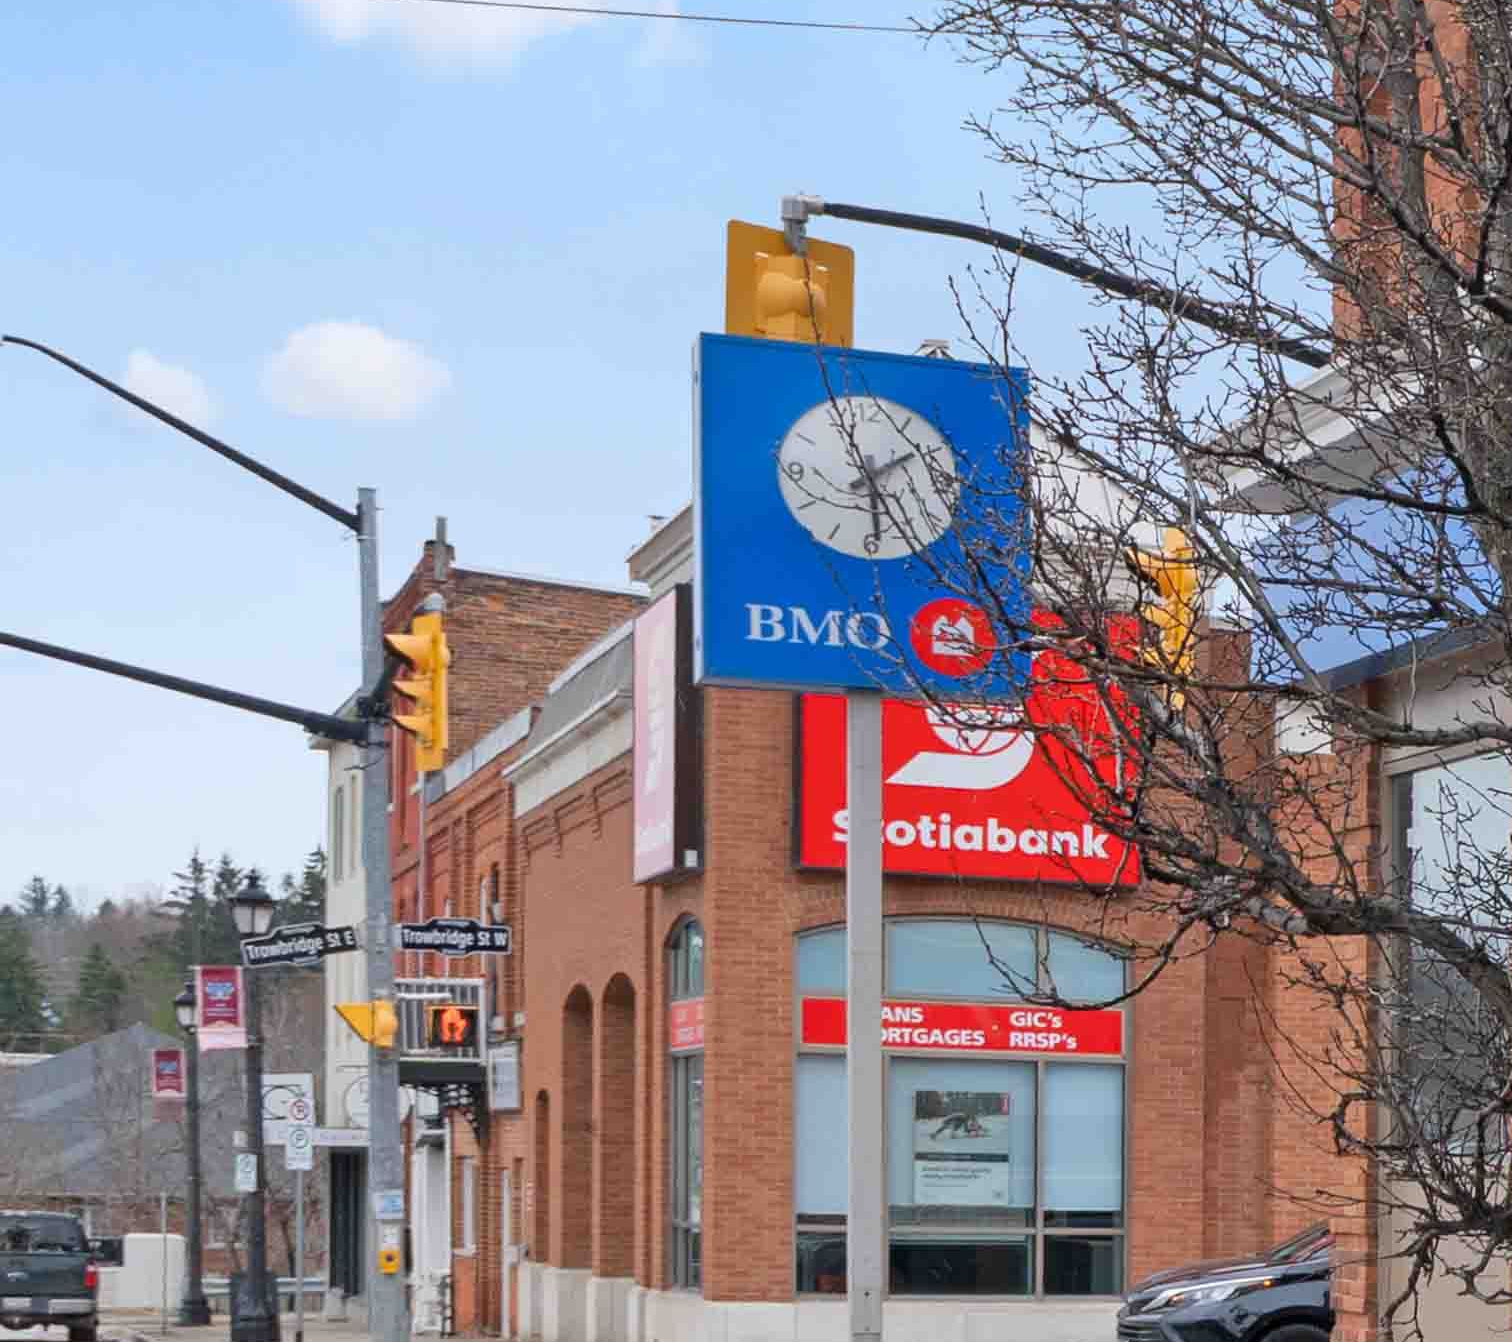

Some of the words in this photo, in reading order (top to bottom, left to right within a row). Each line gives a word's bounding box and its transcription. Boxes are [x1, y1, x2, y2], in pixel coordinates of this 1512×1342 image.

[745, 603, 891, 652] BMO
[832, 808, 1109, 859] Sotiabank
[246, 935, 324, 958] Trowbridge
[325, 932, 341, 948] St
[343, 931, 355, 945] E
[403, 927, 474, 949] Trowbridge
[477, 931, 490, 946] St
[880, 1005, 924, 1023] ANS
[1009, 1011, 1063, 1028] GIC's
[880, 1026, 985, 1045] RTGAGES
[1008, 1031, 1078, 1050] RRSP's
